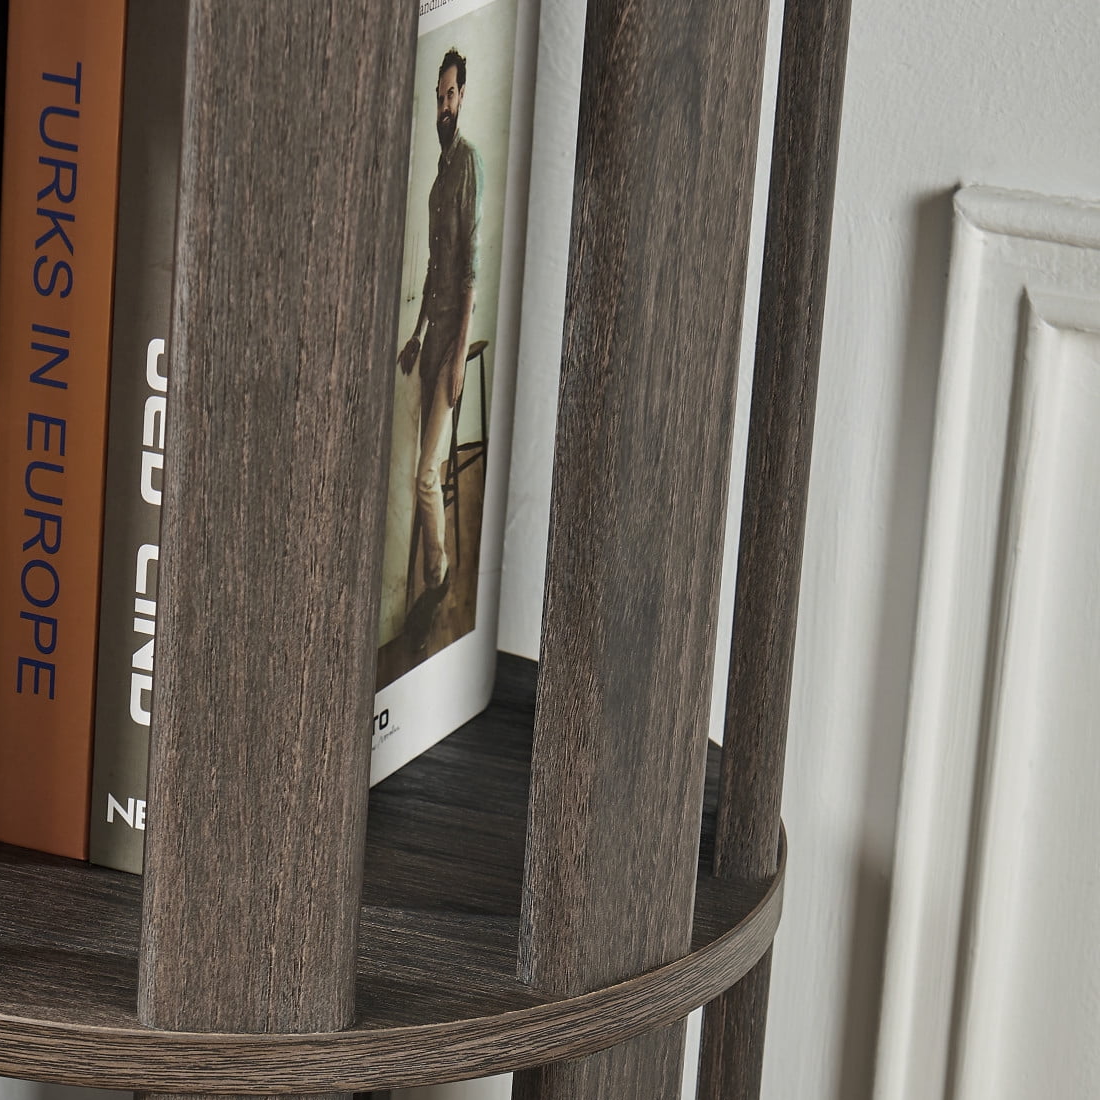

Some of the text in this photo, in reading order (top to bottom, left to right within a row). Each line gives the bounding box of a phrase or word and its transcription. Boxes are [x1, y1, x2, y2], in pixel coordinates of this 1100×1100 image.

[16, 61, 82, 701] TURKS IN EUROPE
